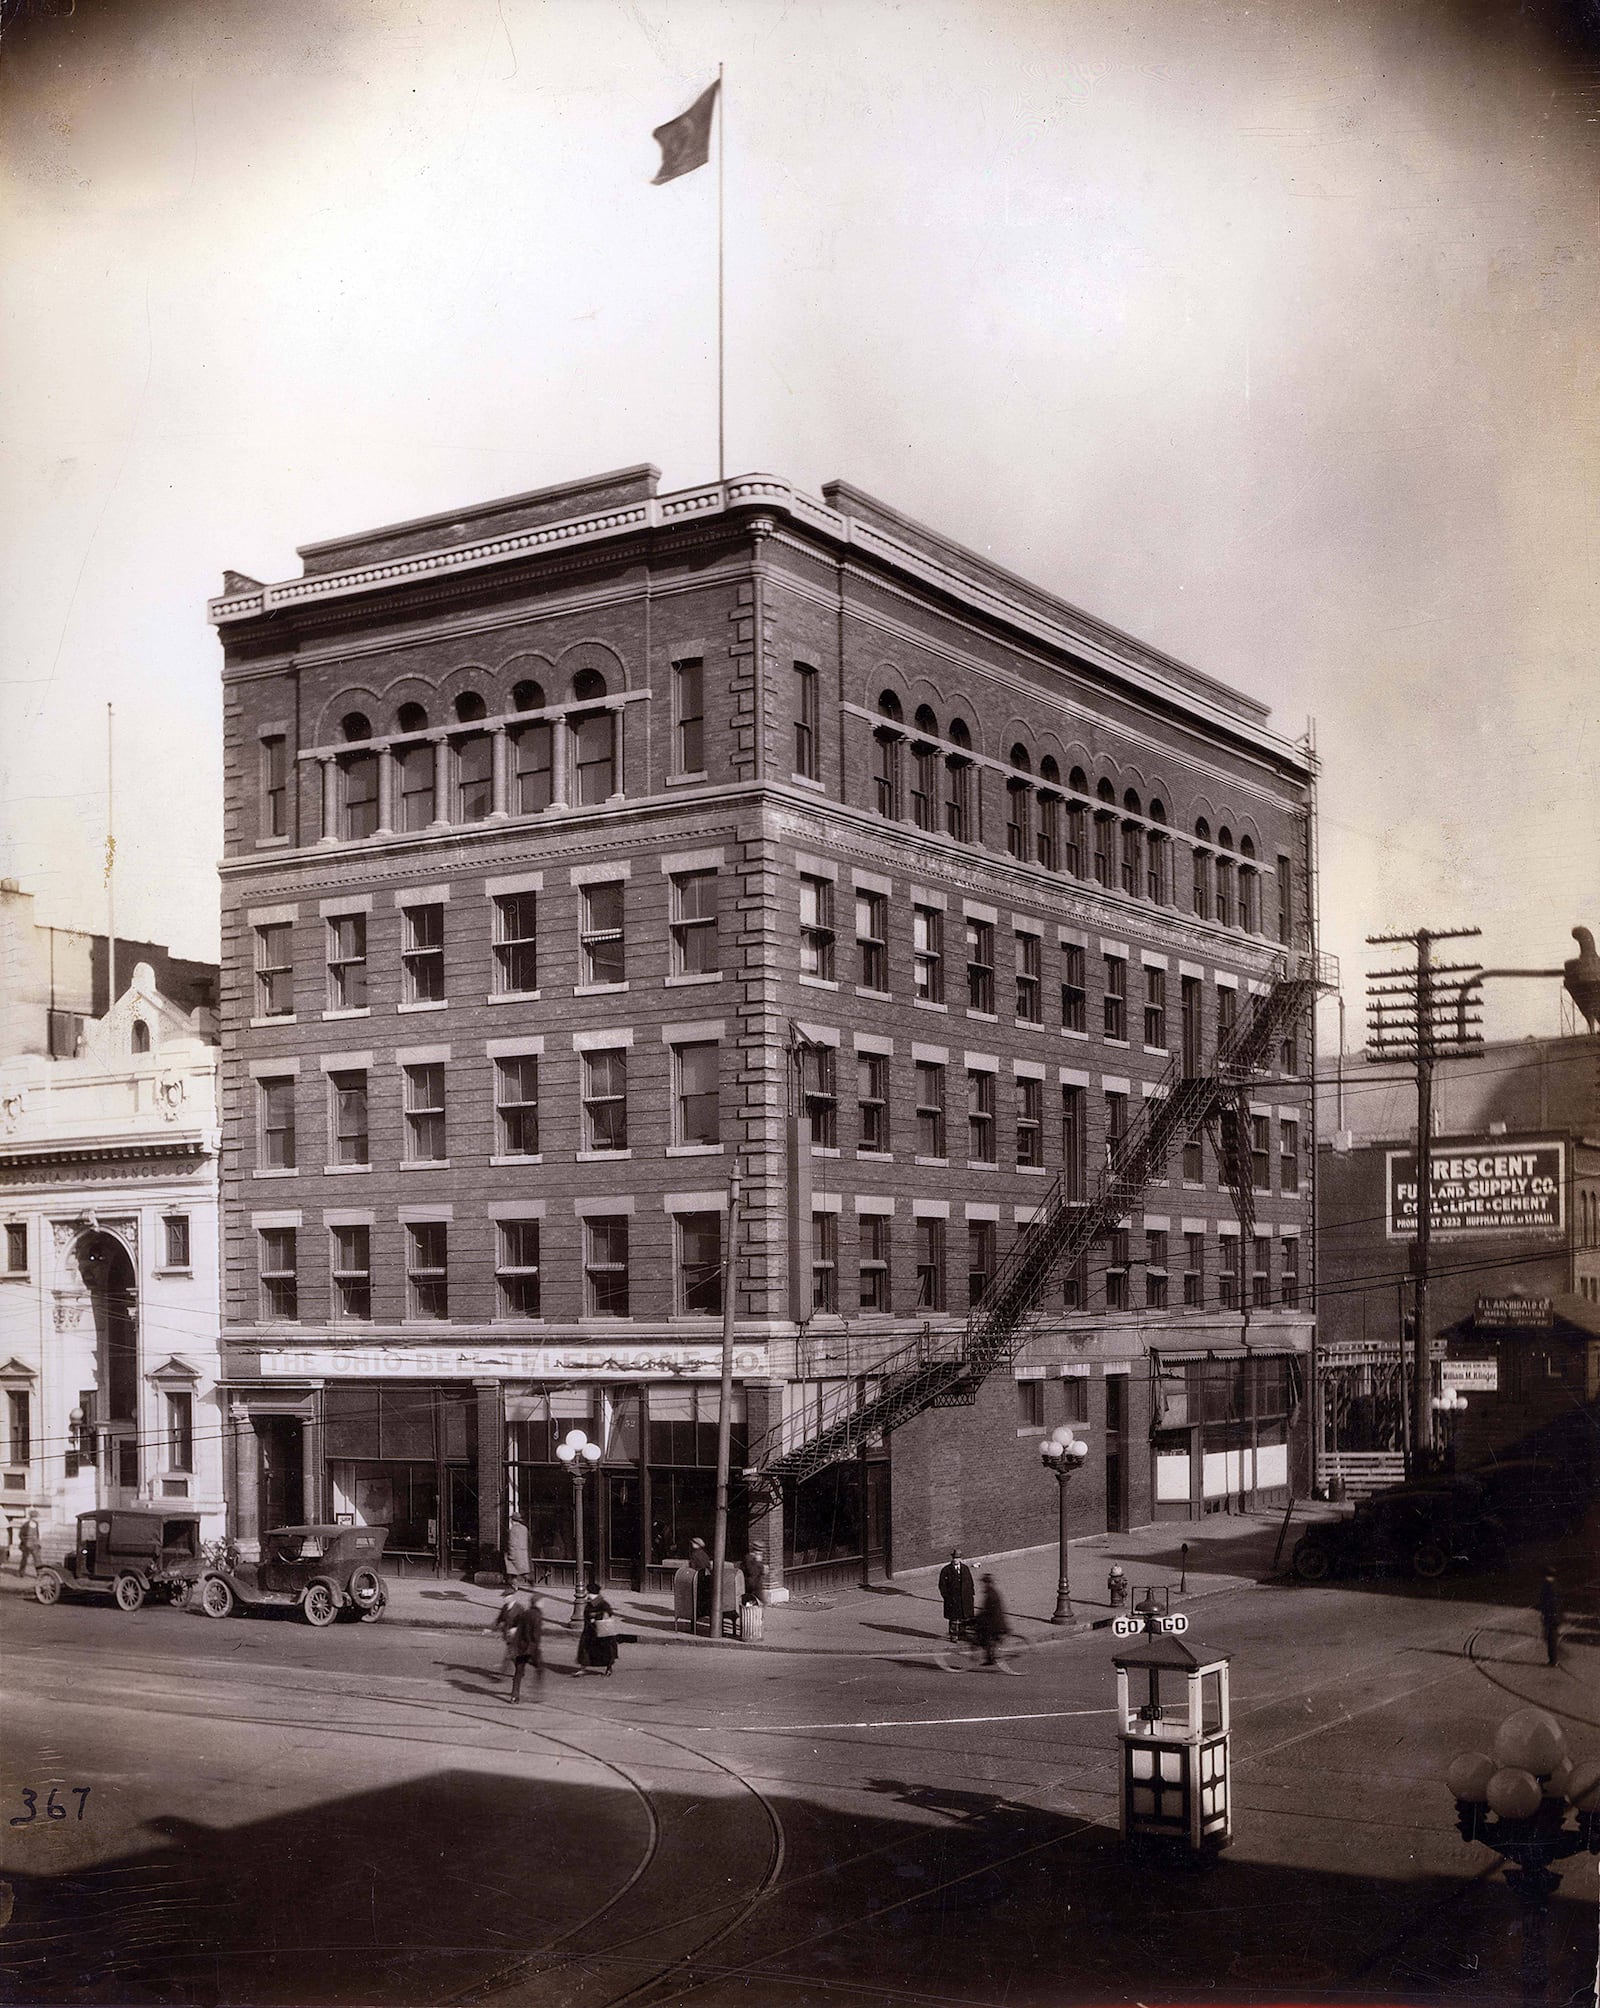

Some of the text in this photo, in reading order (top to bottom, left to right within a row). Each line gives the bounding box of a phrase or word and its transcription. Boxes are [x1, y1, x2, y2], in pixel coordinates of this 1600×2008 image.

[77, 1166, 159, 1181] INSURANCE
[1397, 1177, 1558, 1200] FUL AND SUPPLY CO.
[1403, 1202, 1442, 1215] COL
[1492, 1196, 1549, 1212] CEMENT
[267, 1355, 317, 1372] THE
[331, 1353, 402, 1373] OHIO
[415, 1353, 491, 1372] BELL
[501, 1352, 700, 1373] TELEPHONE
[1115, 1620, 1138, 1634] GO
[1163, 1618, 1186, 1631] GO
[10, 1787, 91, 1826] 367
